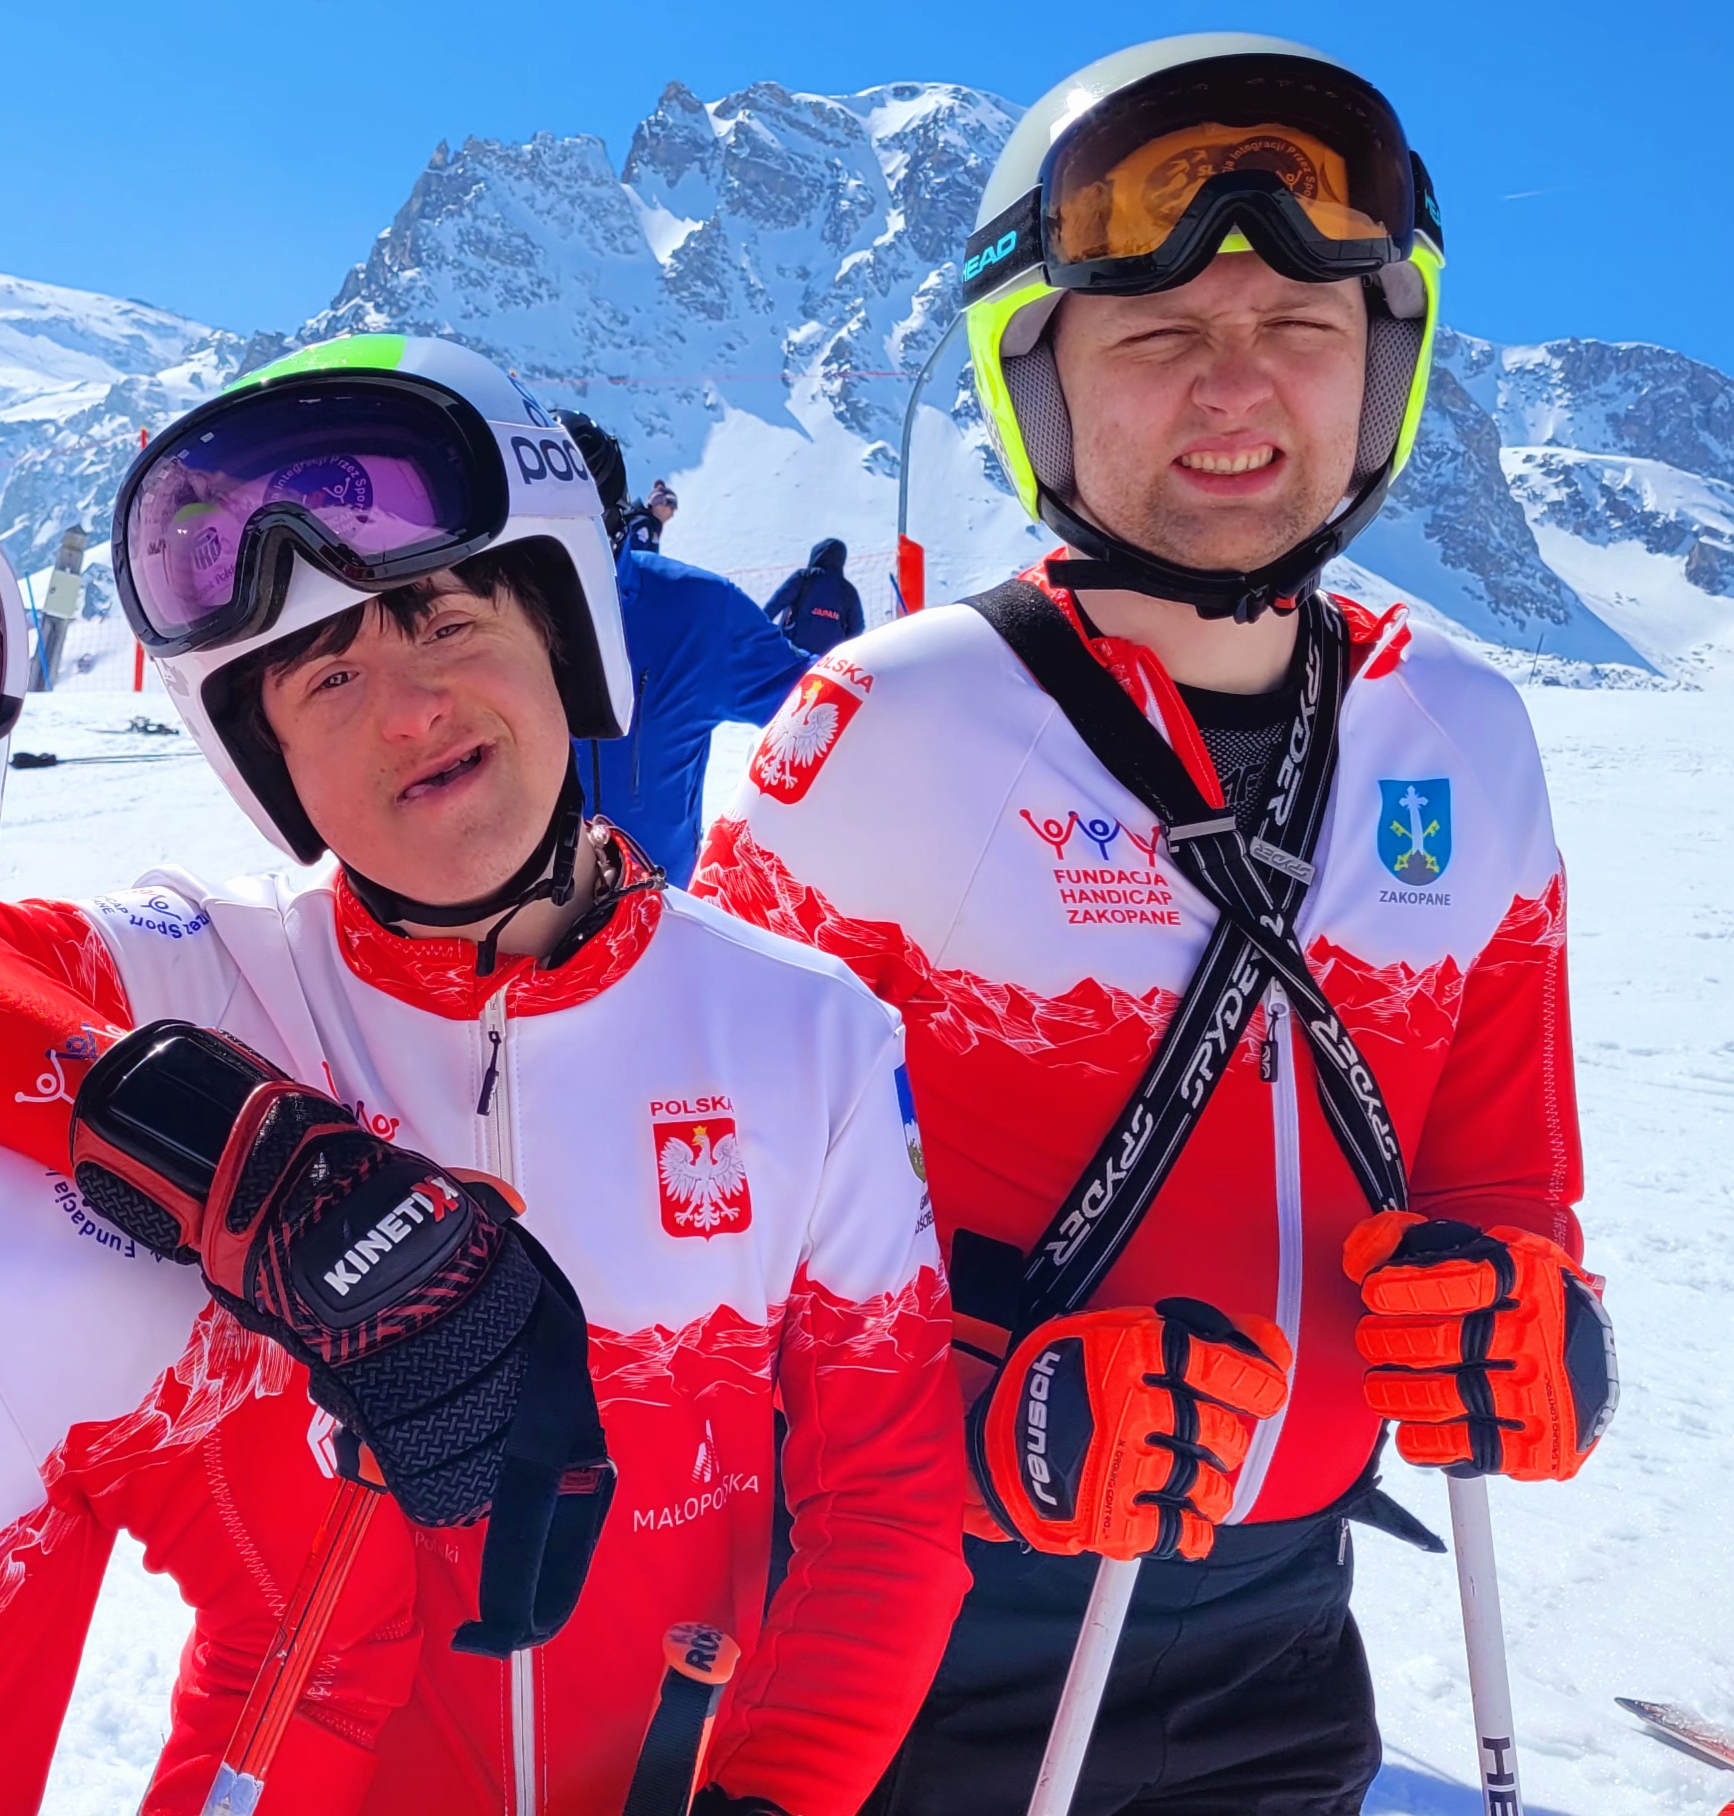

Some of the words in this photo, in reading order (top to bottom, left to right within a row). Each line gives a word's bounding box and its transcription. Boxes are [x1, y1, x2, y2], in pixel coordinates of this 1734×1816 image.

[1052, 869, 1169, 887] FUNDACJA
[1059, 888, 1173, 906] HANDICAP
[1378, 890, 1451, 907] ZAKOPANE
[1066, 909, 1182, 926] ZAKOPANE
[1310, 1014, 1398, 1162] SPYDER
[1044, 1103, 1154, 1267] SPYDER
[54, 1180, 136, 1259] Fundacja
[1026, 1350, 1062, 1507] reusch
